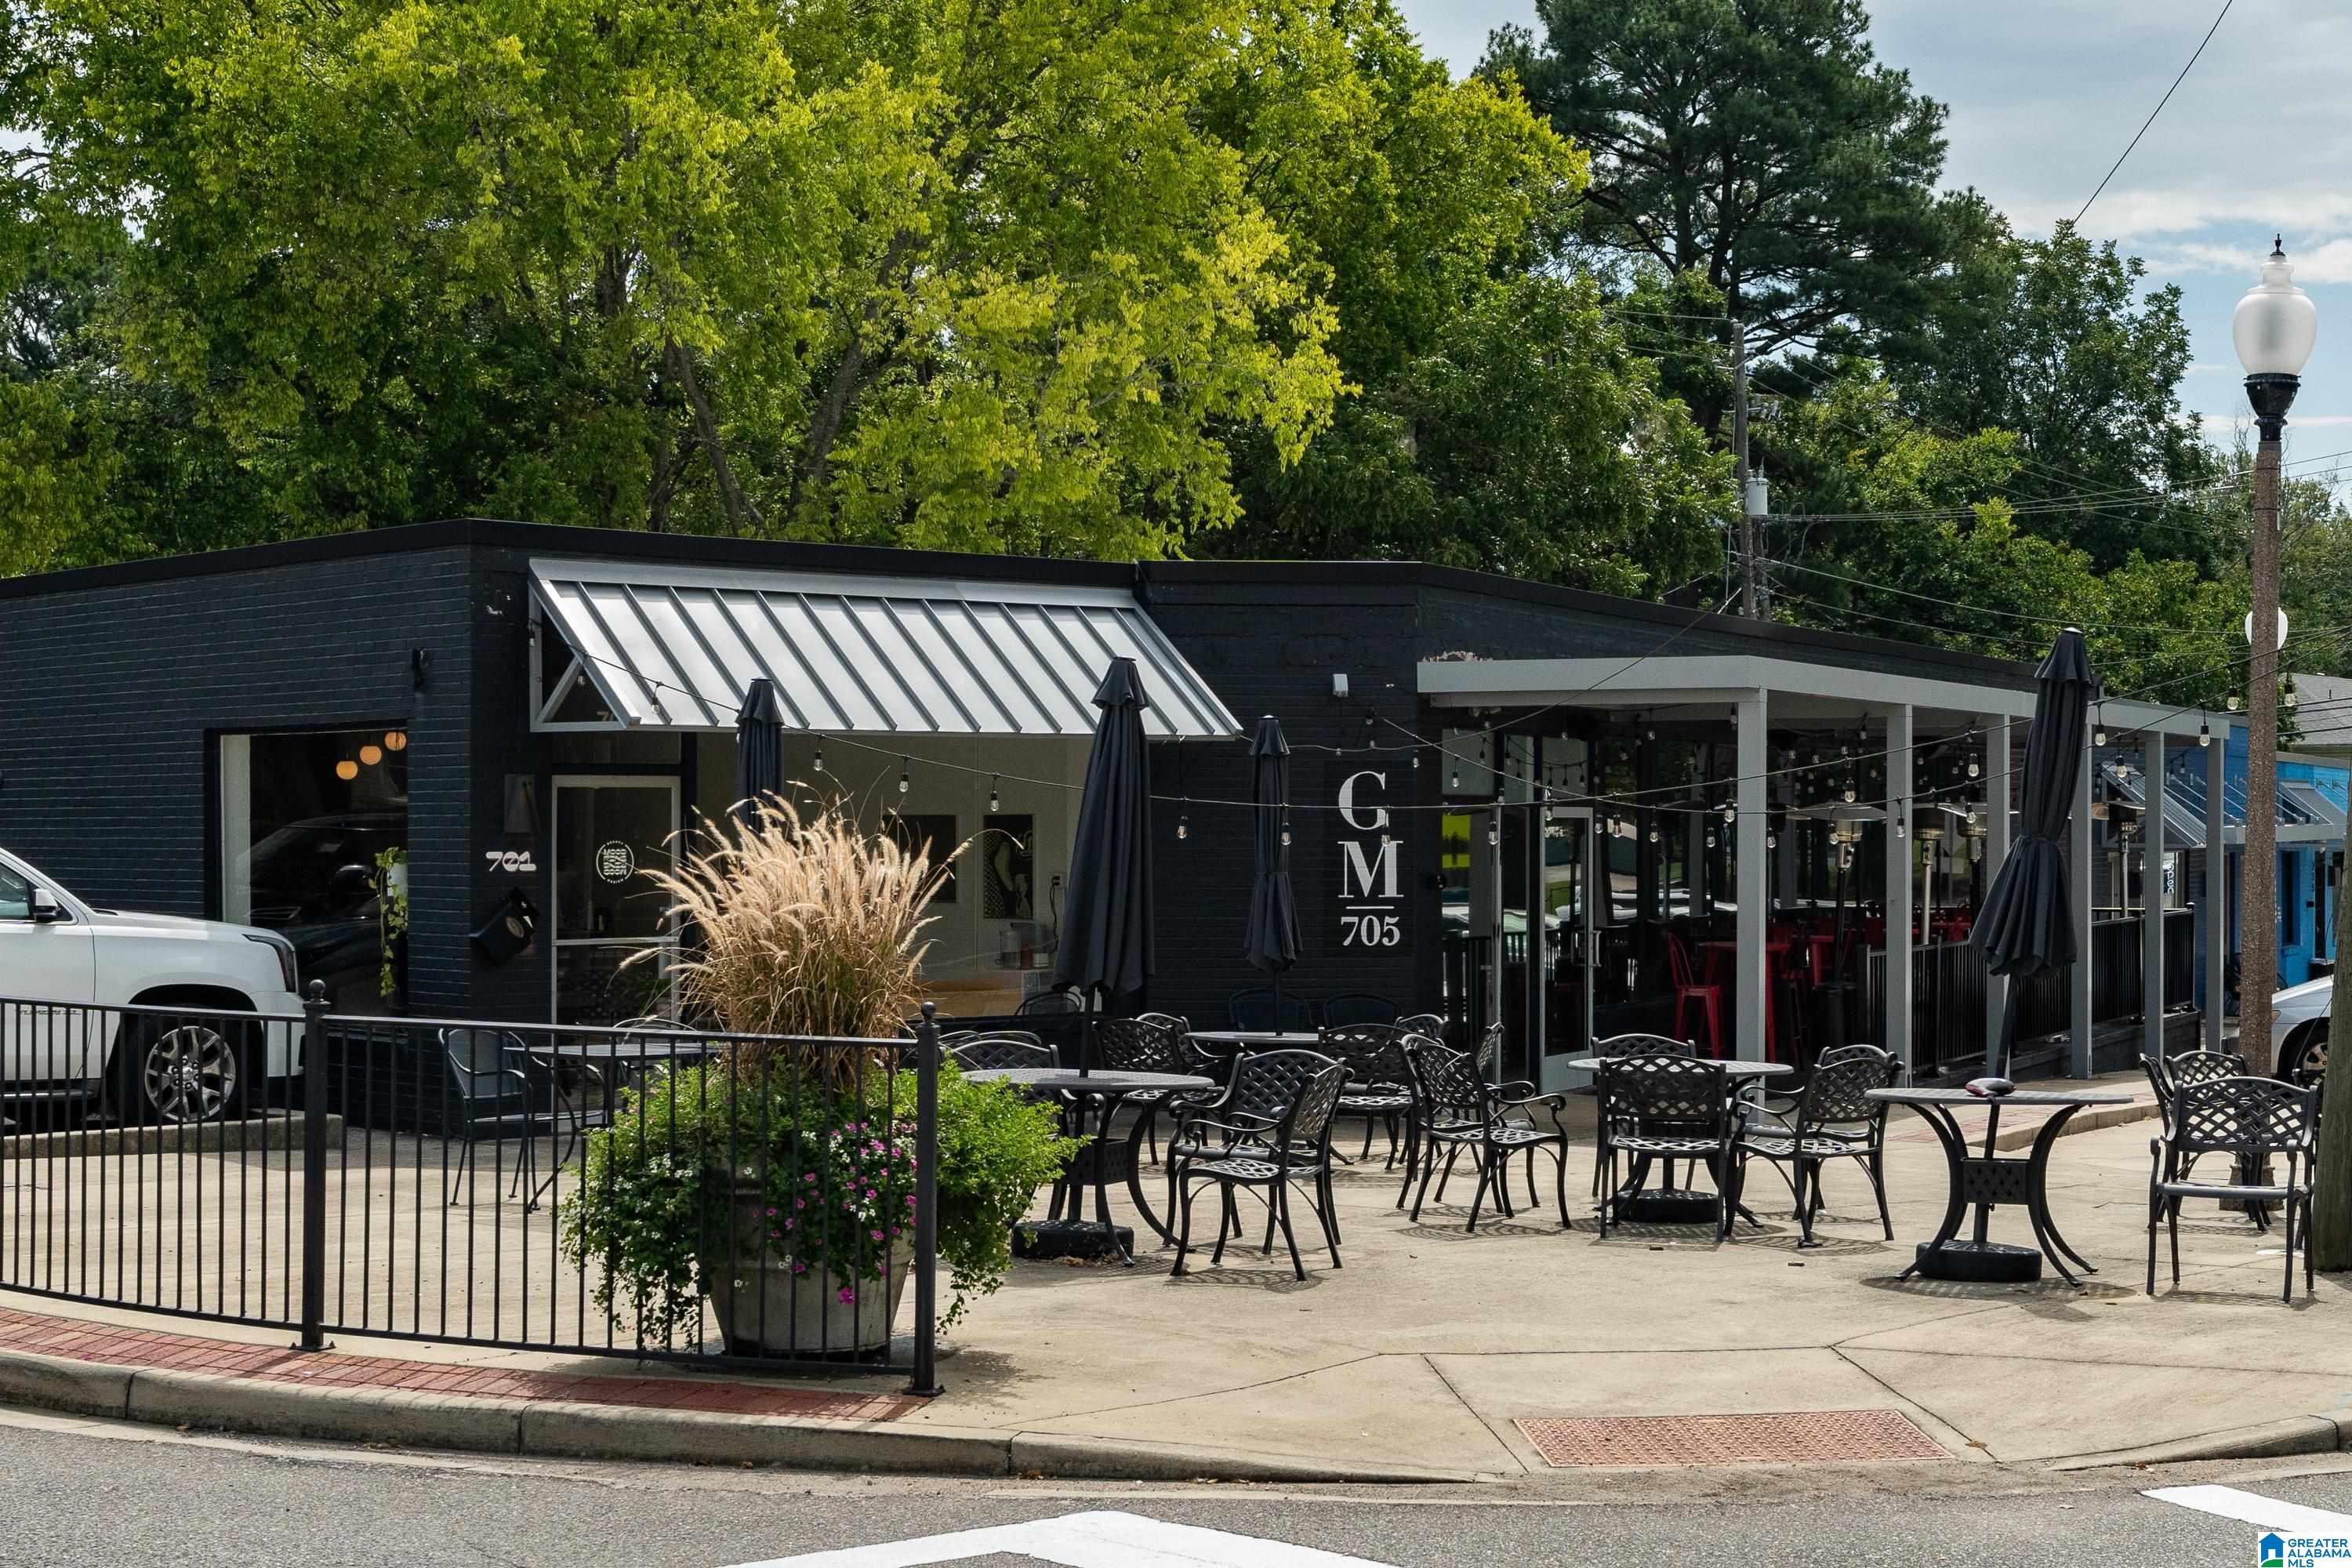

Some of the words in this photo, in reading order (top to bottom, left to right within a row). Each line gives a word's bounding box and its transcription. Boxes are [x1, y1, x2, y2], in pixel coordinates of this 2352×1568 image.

[1338, 771, 1389, 830] G
[485, 851, 537, 872] 701
[1337, 840, 1404, 898] M
[1341, 915, 1401, 946] 705
